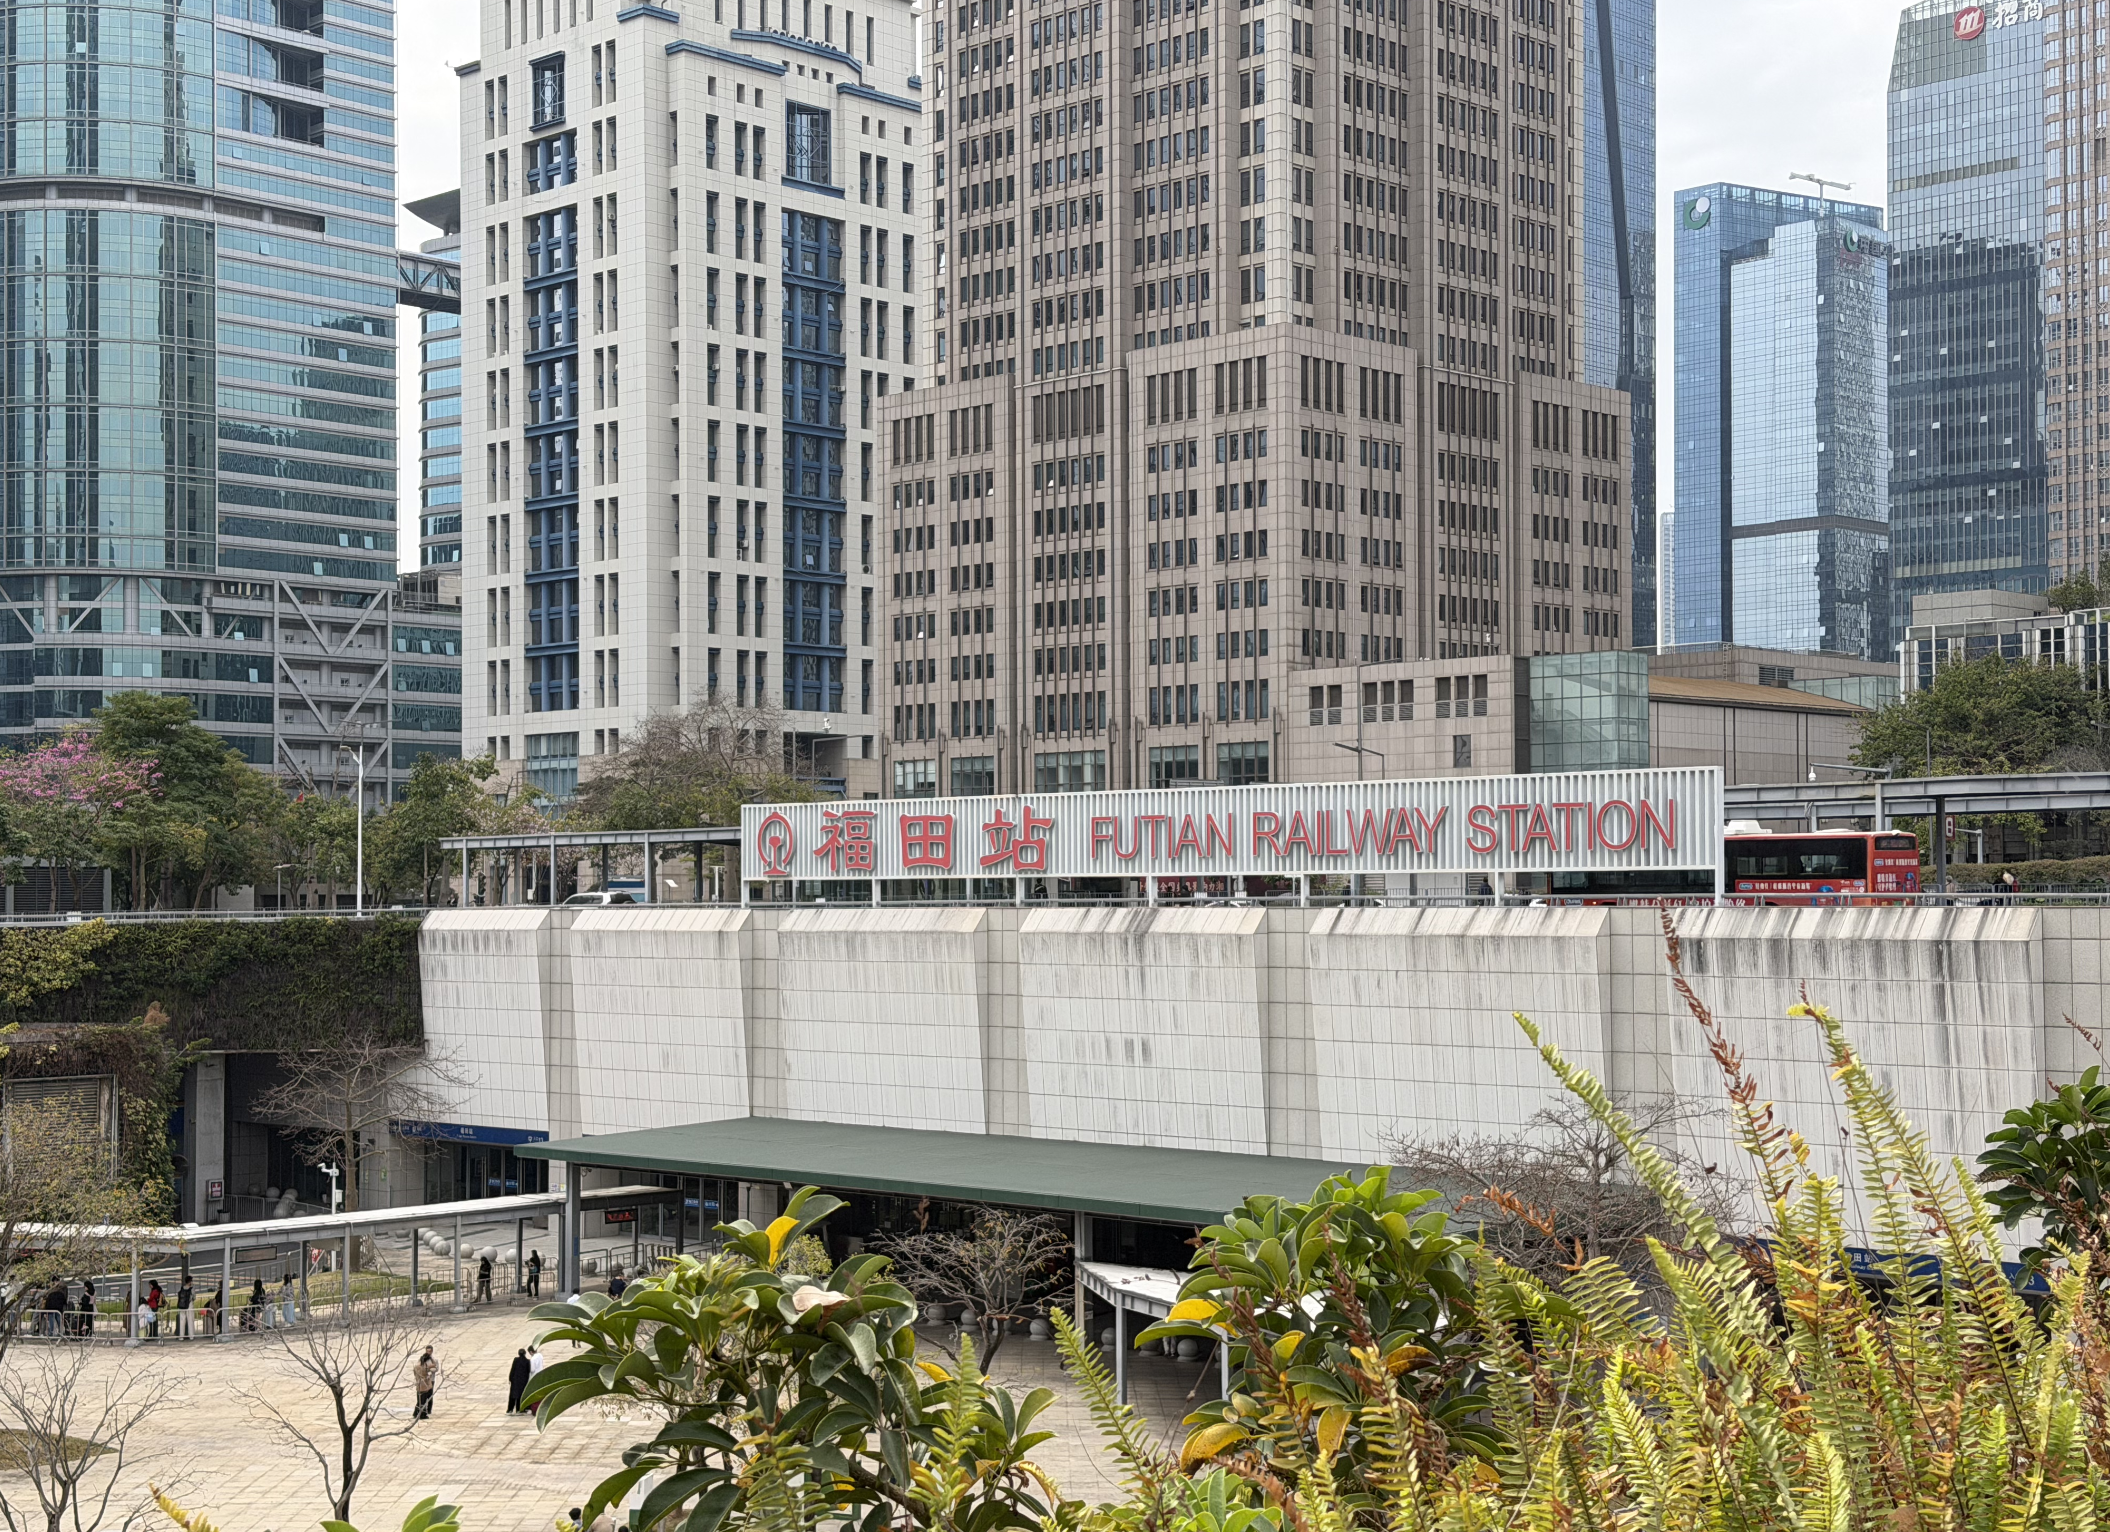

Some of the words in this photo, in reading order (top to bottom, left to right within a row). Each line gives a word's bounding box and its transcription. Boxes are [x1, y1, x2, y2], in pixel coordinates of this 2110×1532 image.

[813, 805, 1055, 872] 福田站
[1090, 812, 1233, 860] FUTIAN
[1252, 806, 1448, 856] RAILWAY
[1467, 799, 1675, 854] STATION
